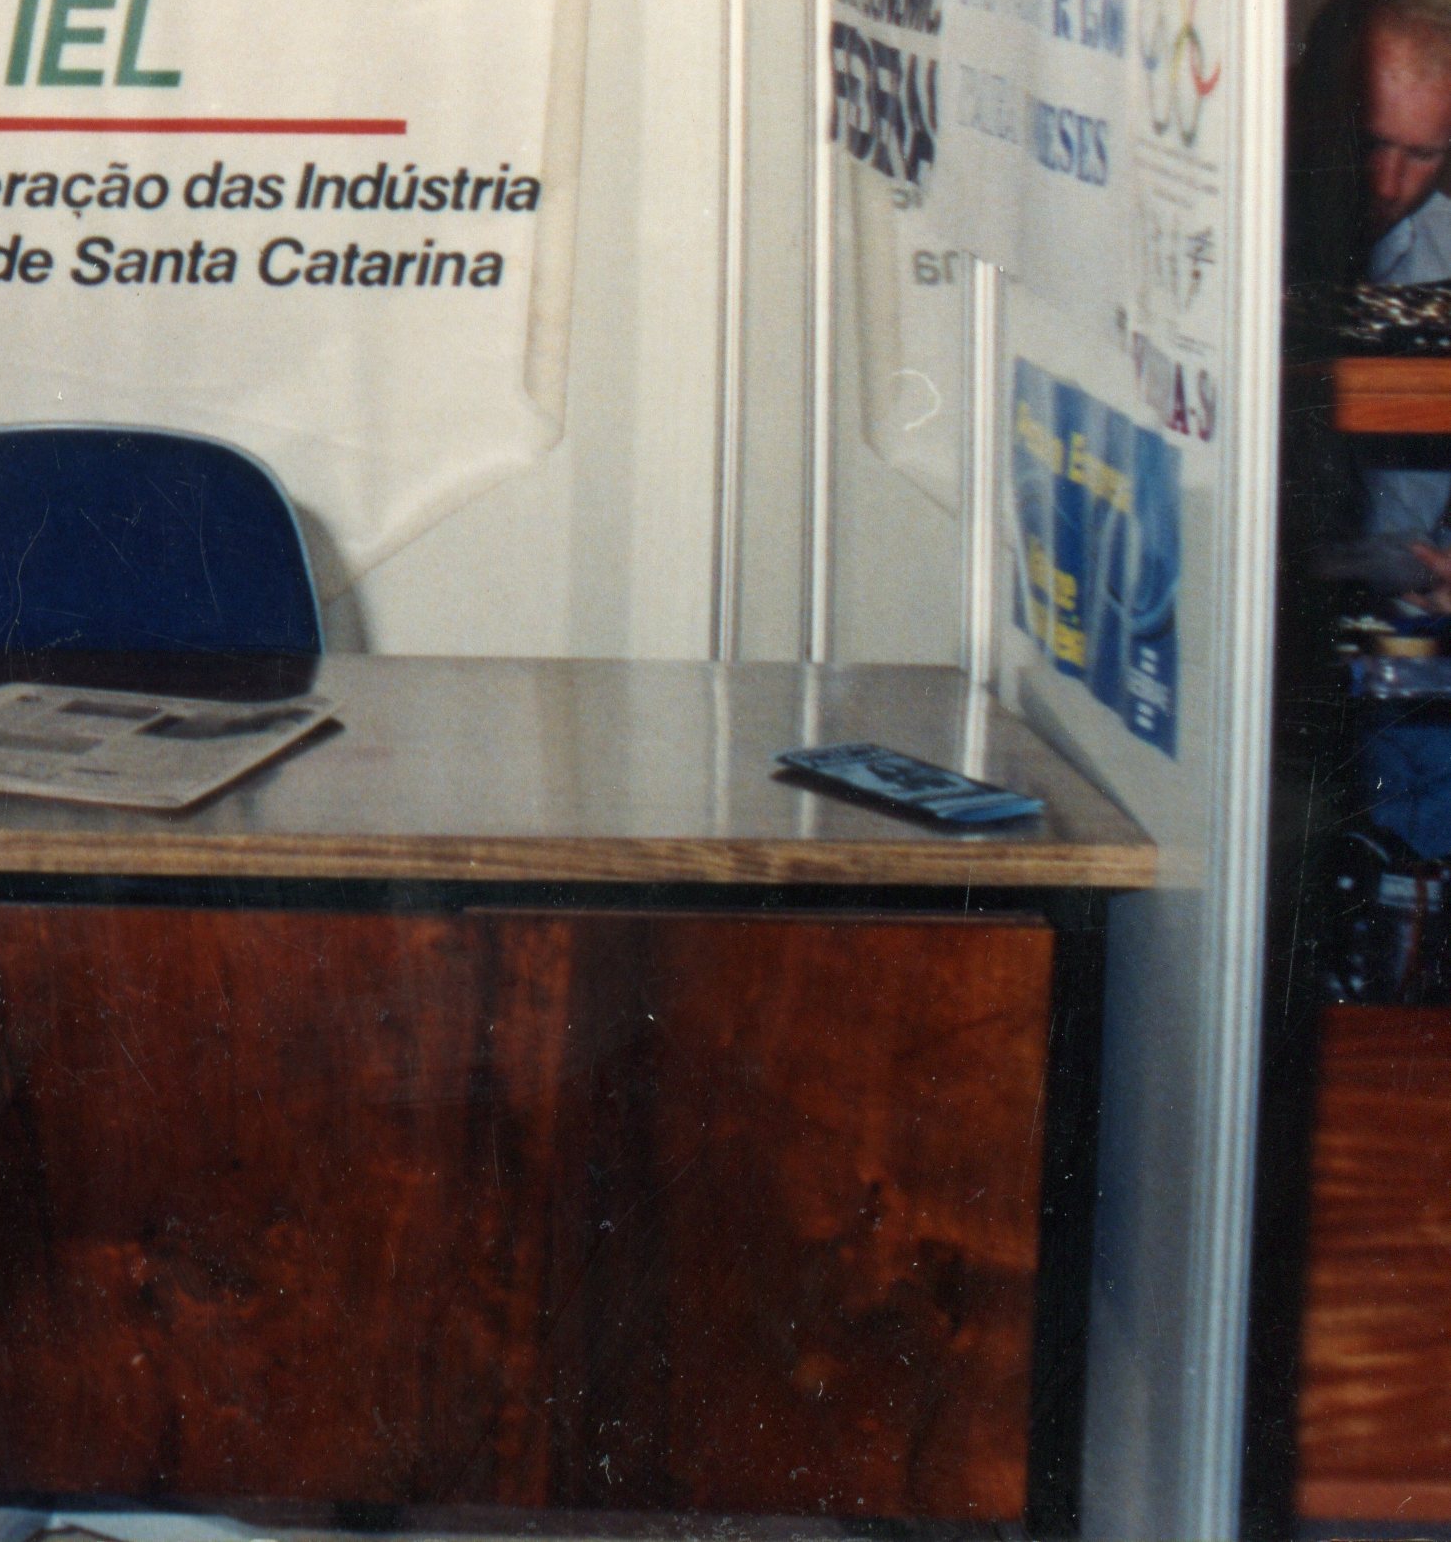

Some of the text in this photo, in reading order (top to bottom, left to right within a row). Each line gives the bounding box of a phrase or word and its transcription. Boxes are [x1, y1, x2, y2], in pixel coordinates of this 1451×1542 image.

[183, 160, 286, 212] das
[293, 161, 542, 215] Indústria
[69, 235, 239, 288] Santa
[258, 235, 505, 291] Catarina
